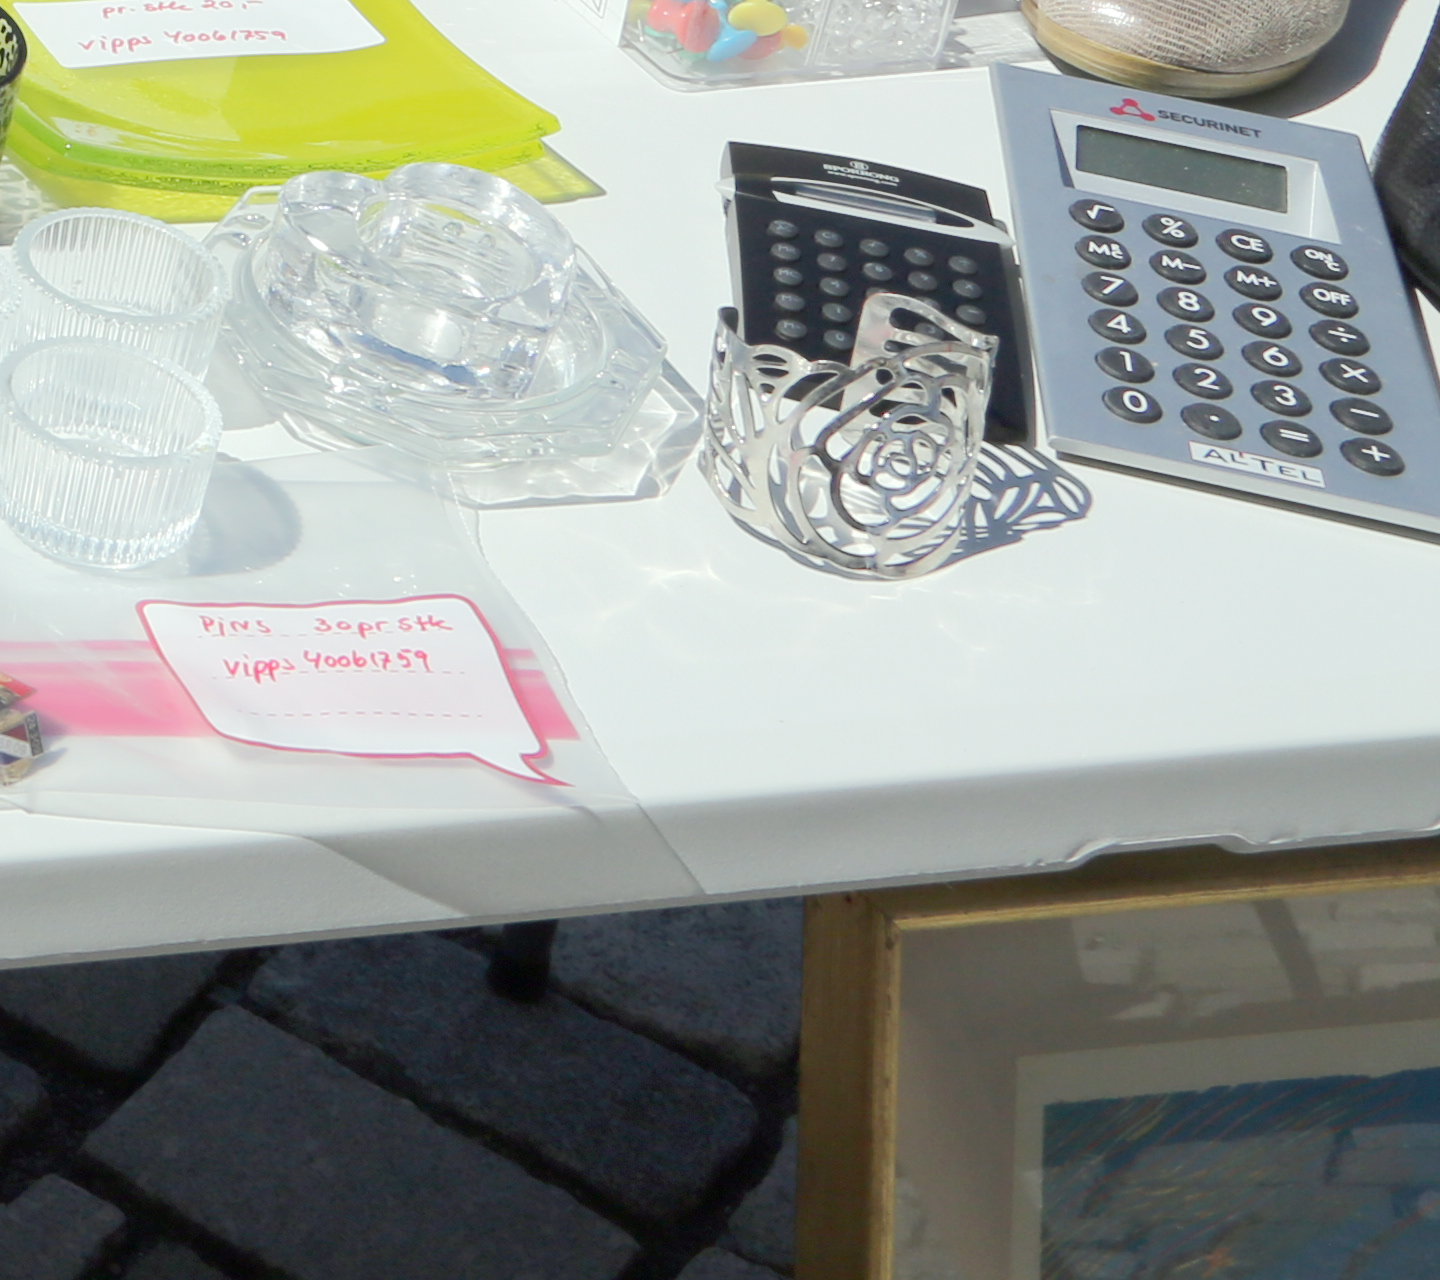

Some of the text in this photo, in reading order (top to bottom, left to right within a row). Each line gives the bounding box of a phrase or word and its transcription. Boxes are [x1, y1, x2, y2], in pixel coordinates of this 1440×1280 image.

[163, 29, 288, 43] 40061759
[1157, 109, 1262, 139] SECURINET
[1230, 234, 1265, 253] CE
[1099, 275, 1352, 328] 7 8 9 OFF
[1107, 314, 1290, 368] 4 5 6
[1119, 351, 1297, 406] 1 2 3
[1122, 390, 1149, 413] 0
[303, 649, 431, 672] 40061759
